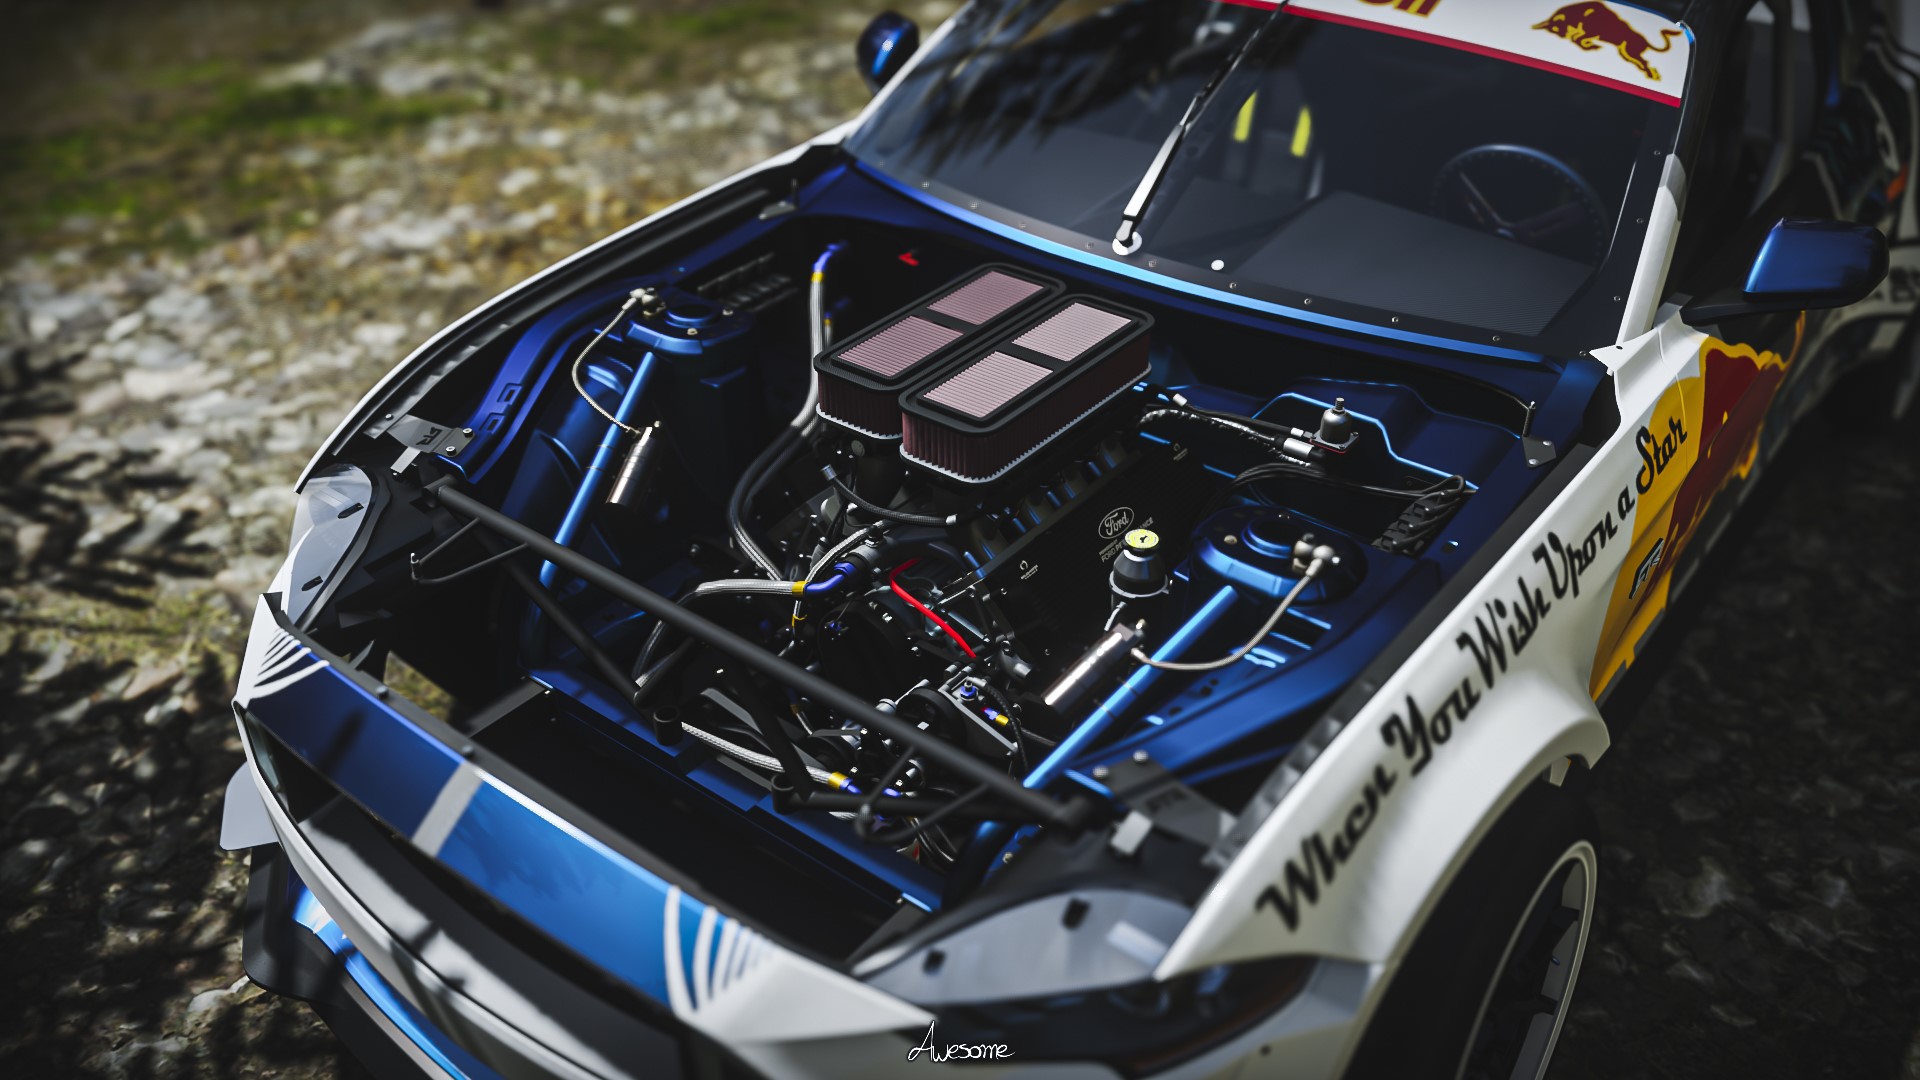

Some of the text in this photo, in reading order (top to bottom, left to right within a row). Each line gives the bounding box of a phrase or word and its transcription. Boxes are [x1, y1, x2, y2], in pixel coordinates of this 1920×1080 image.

[1101, 547, 1116, 563] FORD
[1255, 416, 1688, 933] When You Wish Upon a Star
